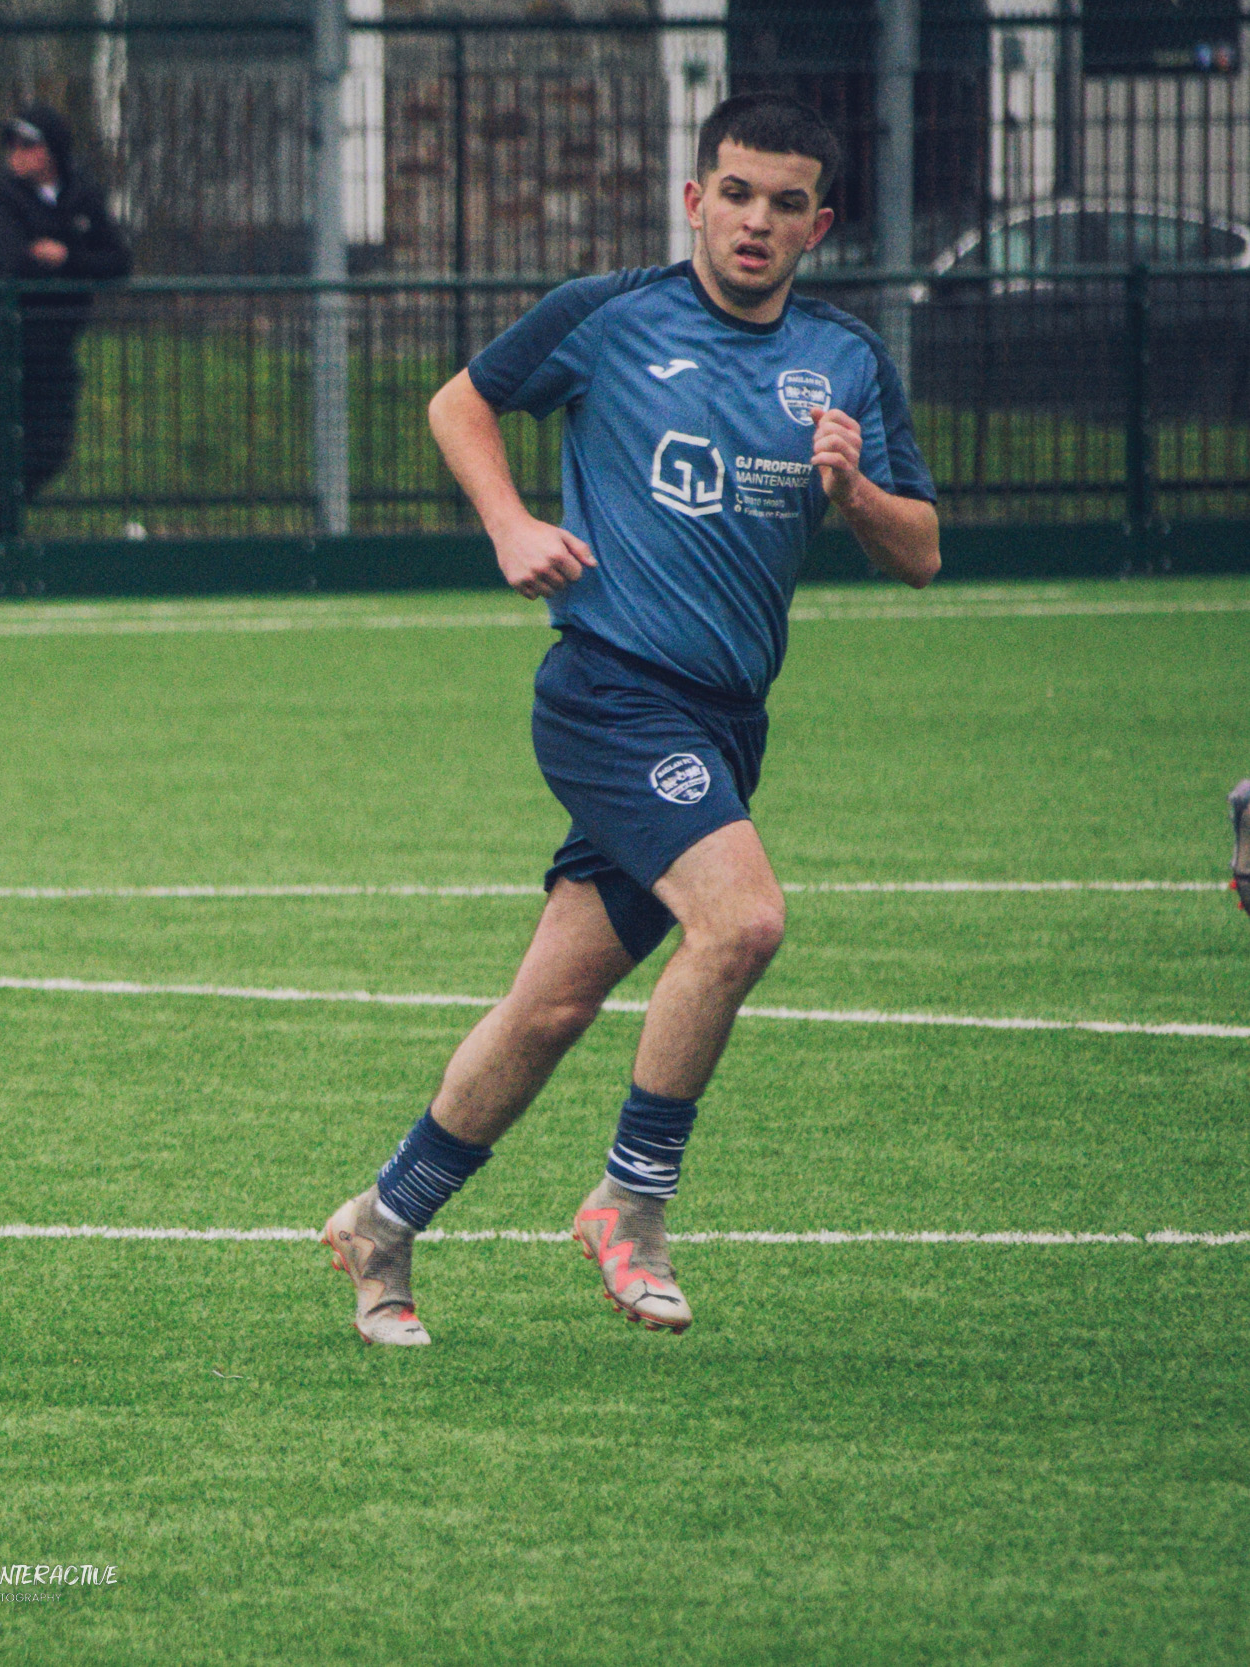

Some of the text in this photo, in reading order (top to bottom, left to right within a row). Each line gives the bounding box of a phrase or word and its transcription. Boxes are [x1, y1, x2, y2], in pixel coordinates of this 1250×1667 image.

[735, 455, 814, 475] GJ PROPERTY
[735, 470, 810, 488] MAINTENANCE
